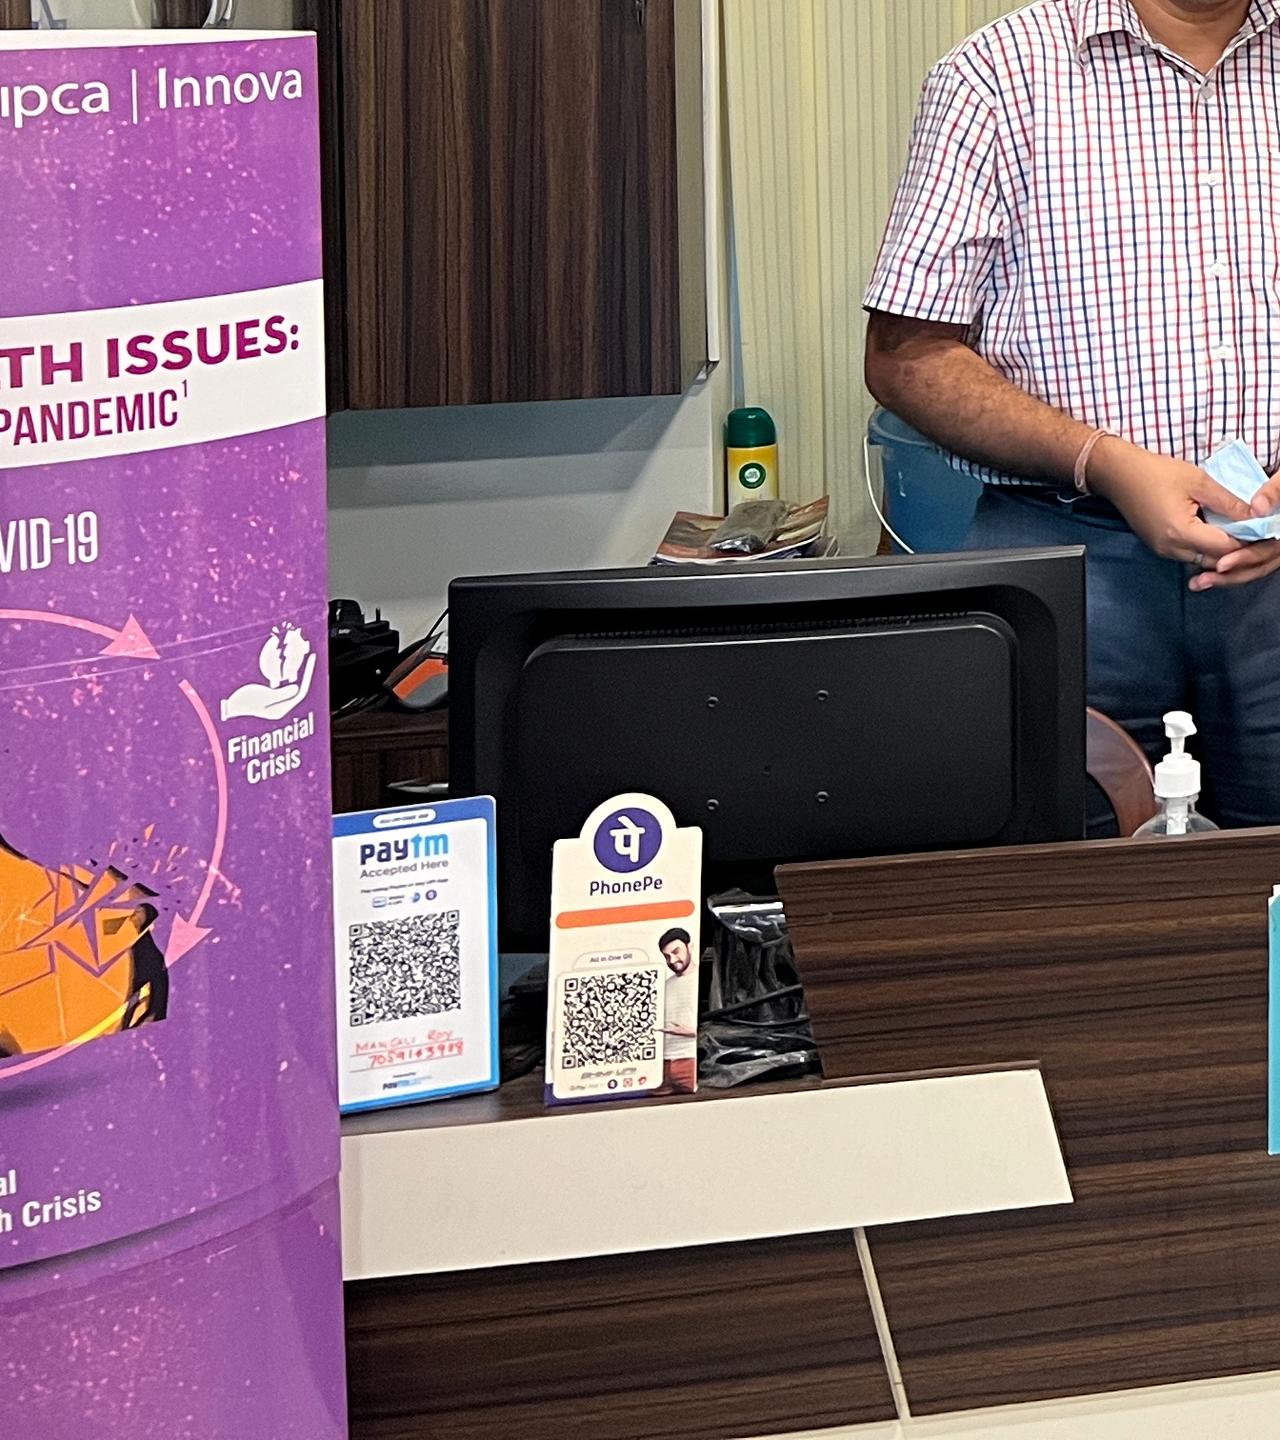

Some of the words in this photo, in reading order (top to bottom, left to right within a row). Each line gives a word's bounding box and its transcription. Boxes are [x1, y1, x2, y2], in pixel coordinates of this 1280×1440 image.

[156, 67, 303, 109] Innova
[106, 314, 300, 380] ISSUES:
[0, 510, 99, 573] VID-19
[227, 712, 315, 763] Financial
[246, 749, 302, 785] Crisis
[360, 862, 418, 879] Accepted
[420, 859, 449, 871] Here
[589, 876, 663, 897] PhonePe
[22, 1189, 102, 1228] Crisis
